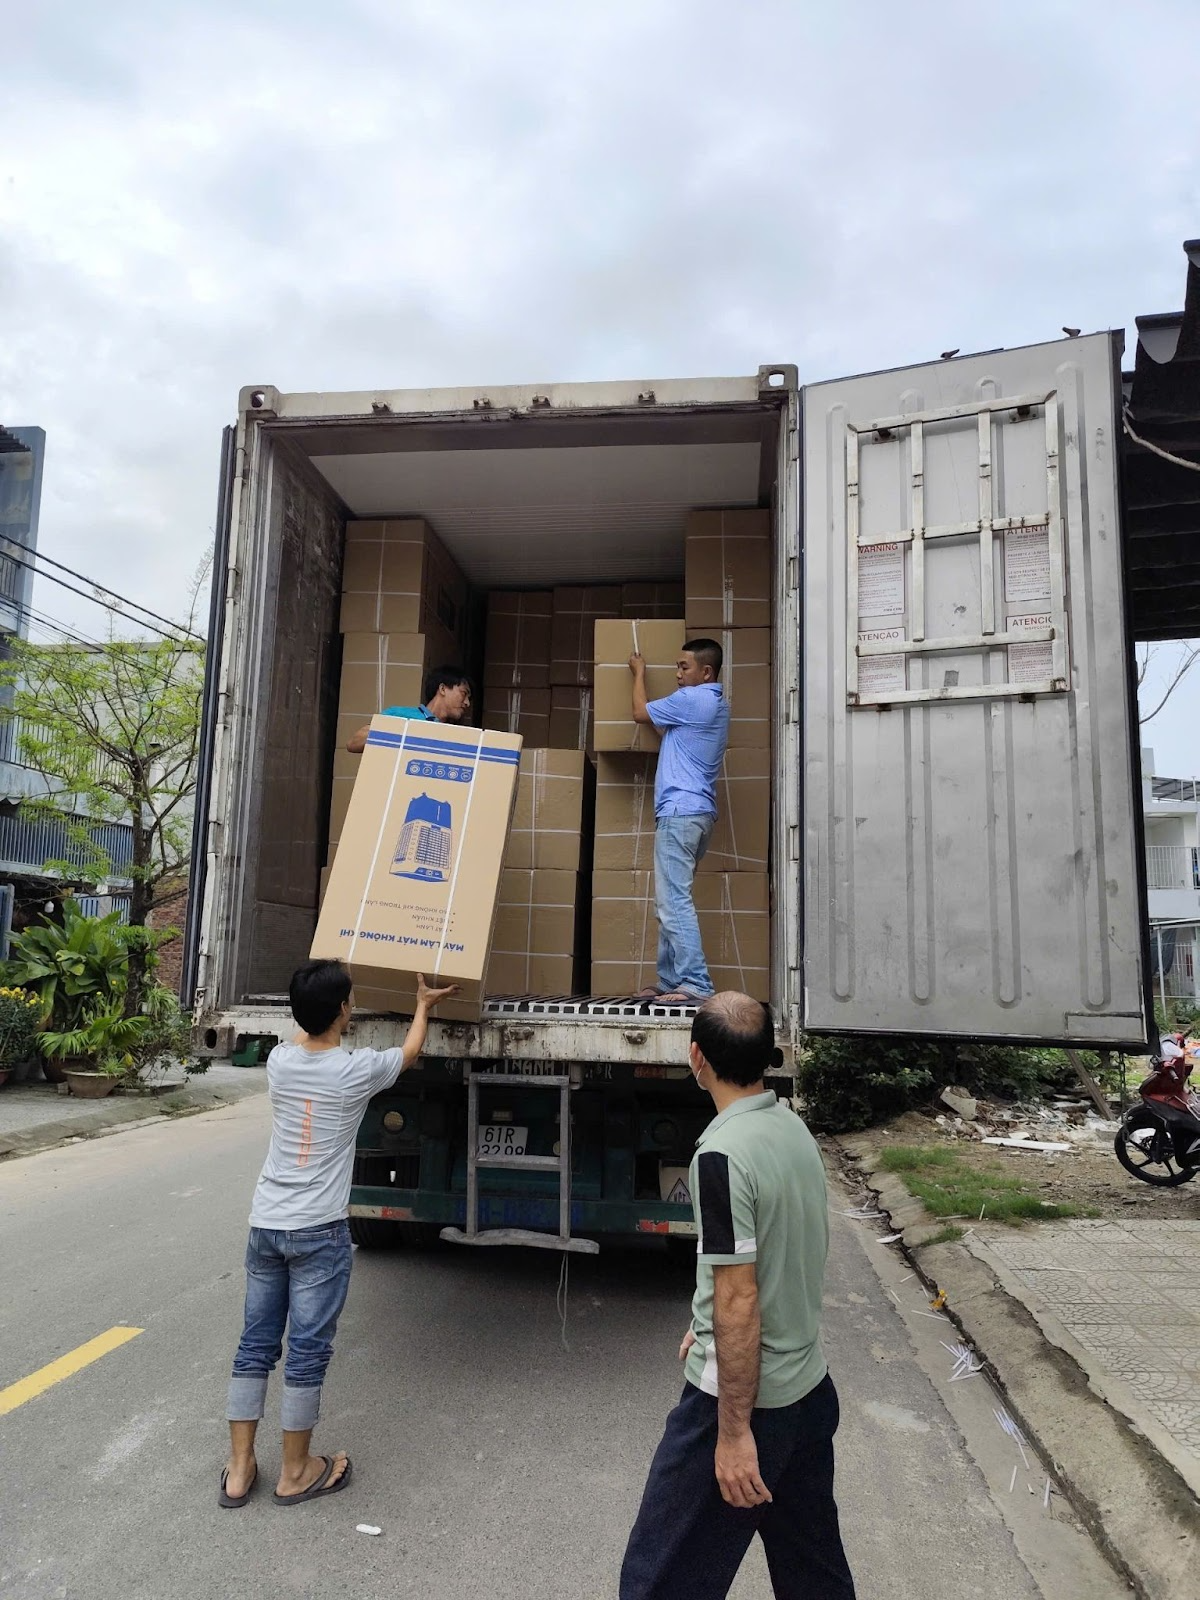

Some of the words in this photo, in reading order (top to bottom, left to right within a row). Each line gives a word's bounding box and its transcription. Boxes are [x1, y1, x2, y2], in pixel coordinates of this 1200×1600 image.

[360, 931, 396, 942] KHÔNG
[397, 936, 419, 946] MÁT
[420, 939, 441, 949] LÀM
[443, 942, 464, 952] MÁY
[485, 1127, 515, 1143] 61R
